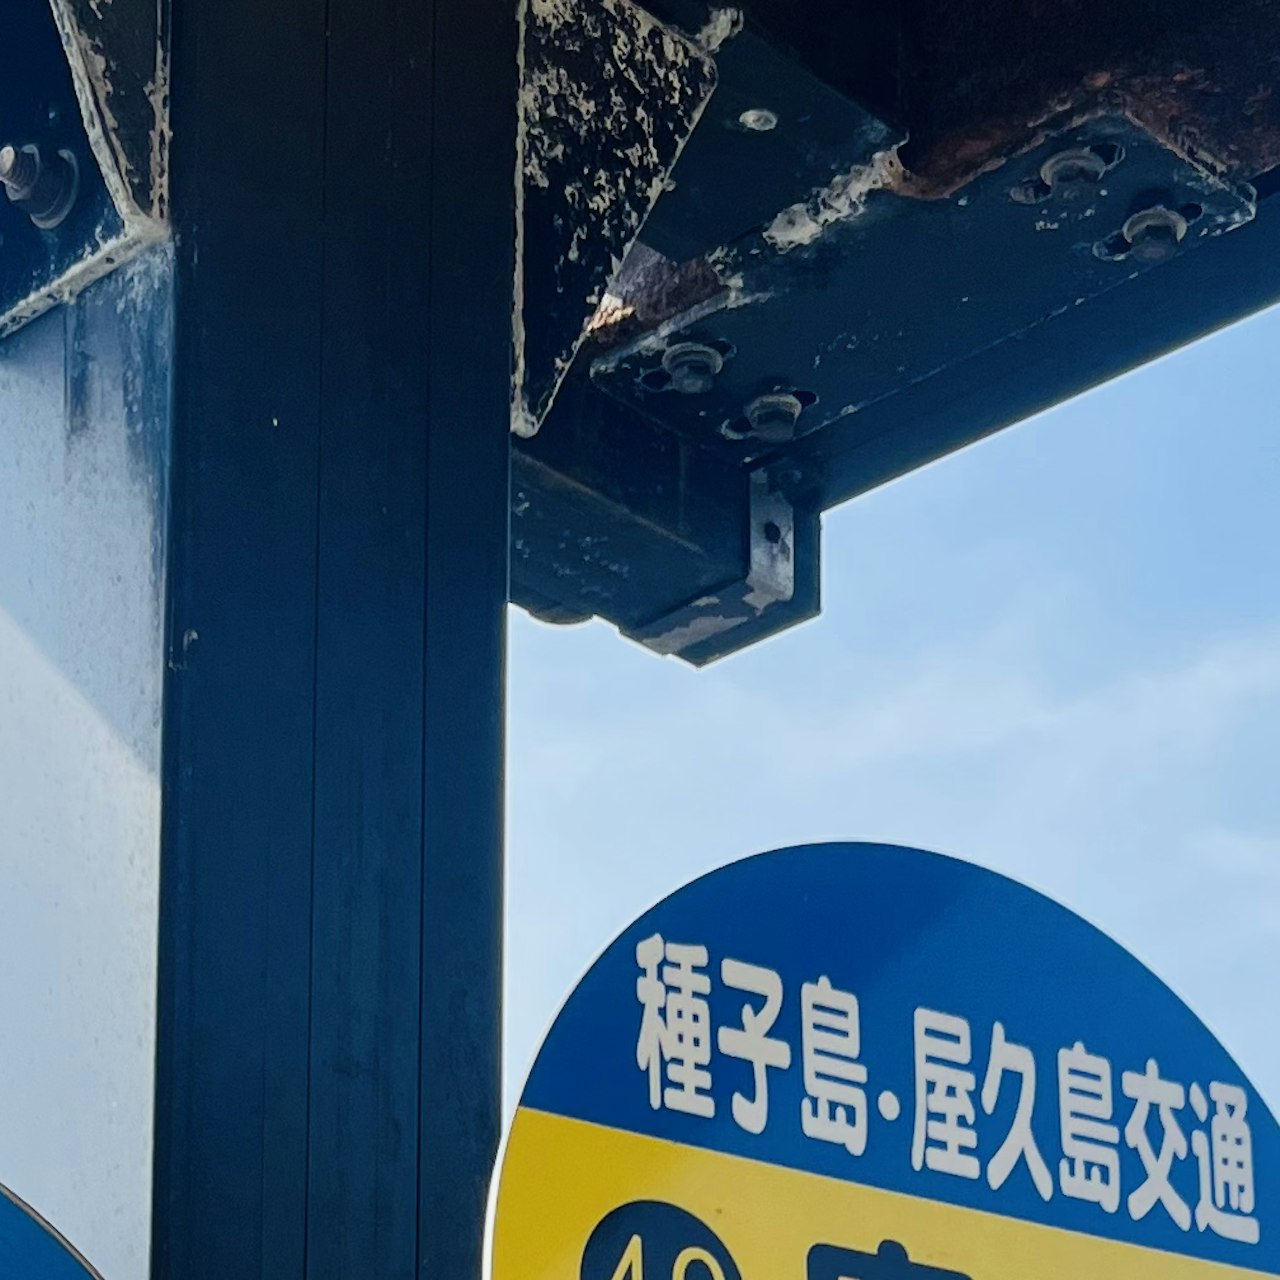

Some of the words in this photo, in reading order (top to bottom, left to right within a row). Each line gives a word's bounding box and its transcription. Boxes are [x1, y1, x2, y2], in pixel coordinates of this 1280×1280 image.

[636, 933, 1260, 1244] 種子島・屋久島交通
